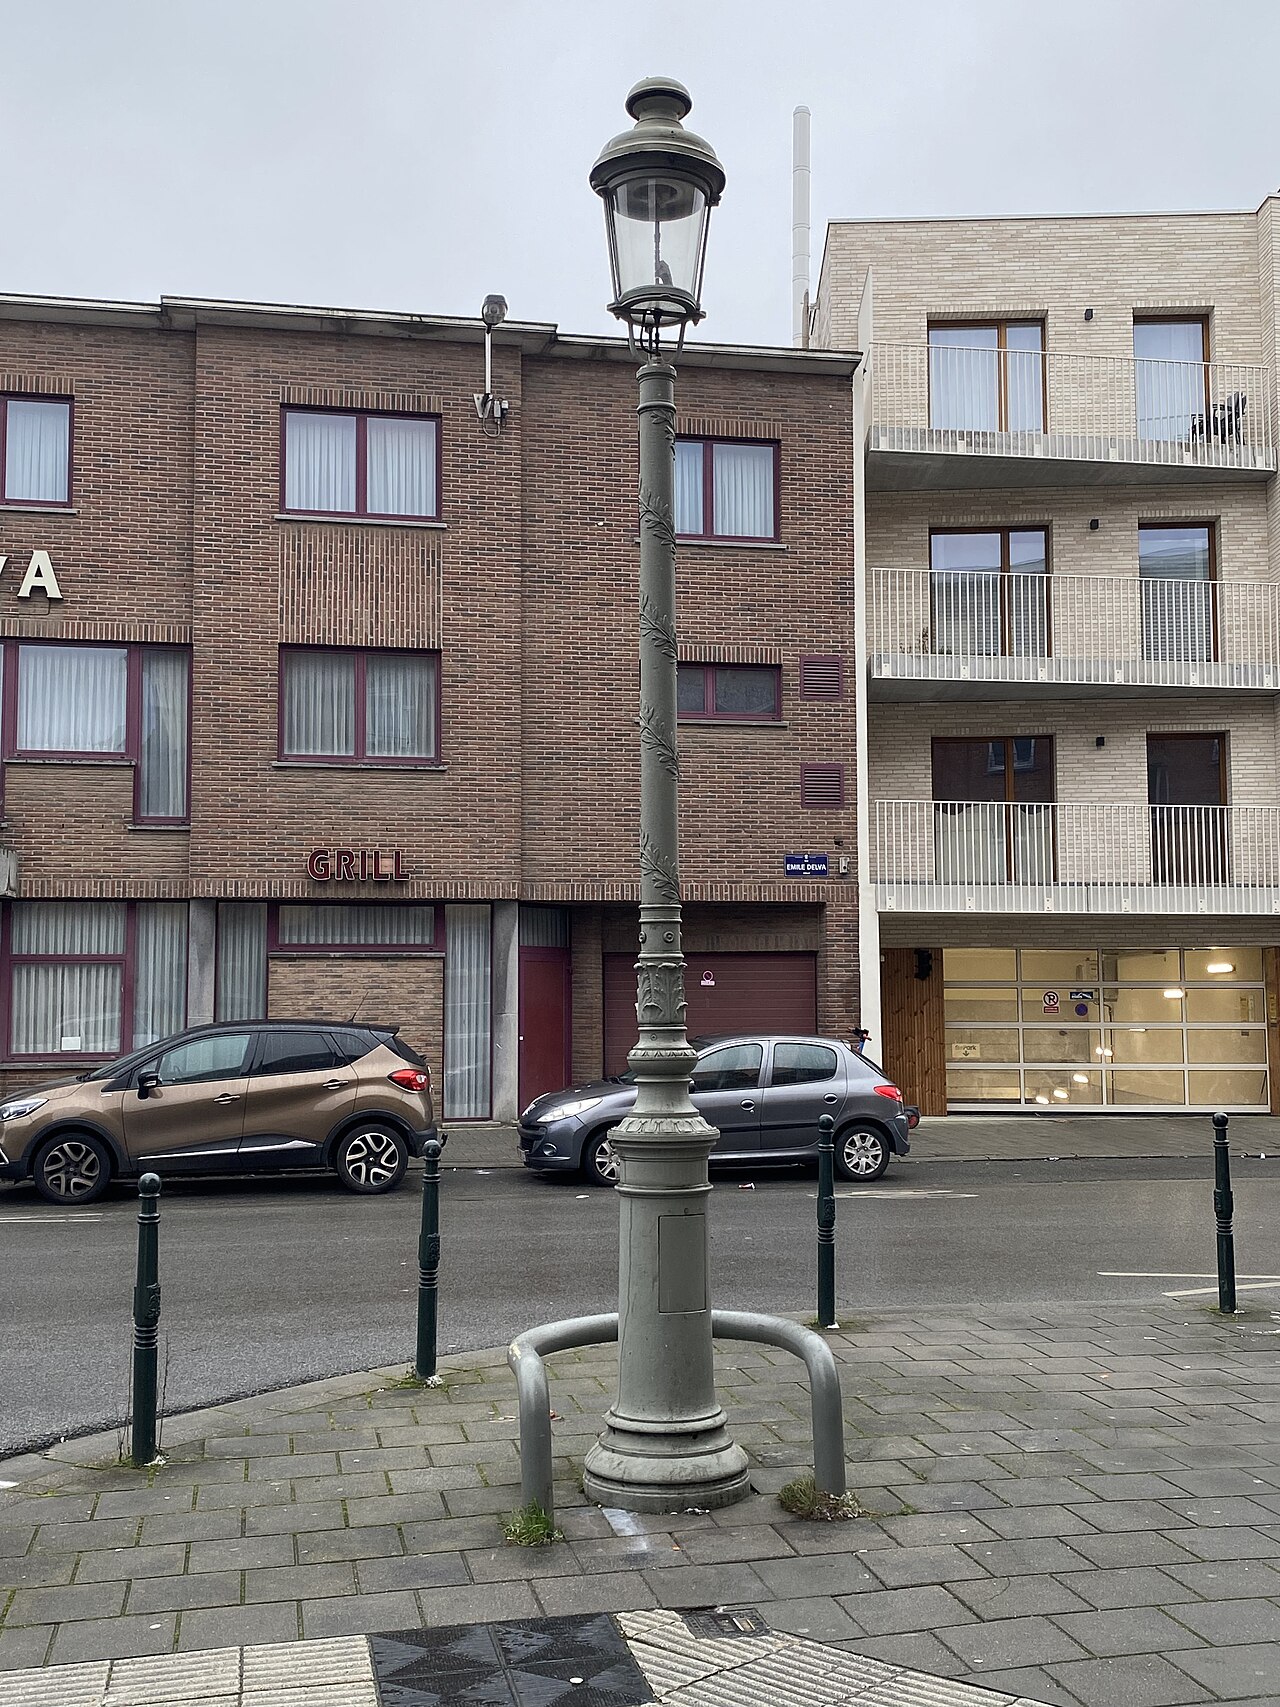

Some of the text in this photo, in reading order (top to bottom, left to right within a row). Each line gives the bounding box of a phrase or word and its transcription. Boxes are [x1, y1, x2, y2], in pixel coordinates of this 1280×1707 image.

[0, 550, 63, 598] A
[307, 849, 411, 881] GRILL
[786, 863, 827, 871] EMILE DELVA
